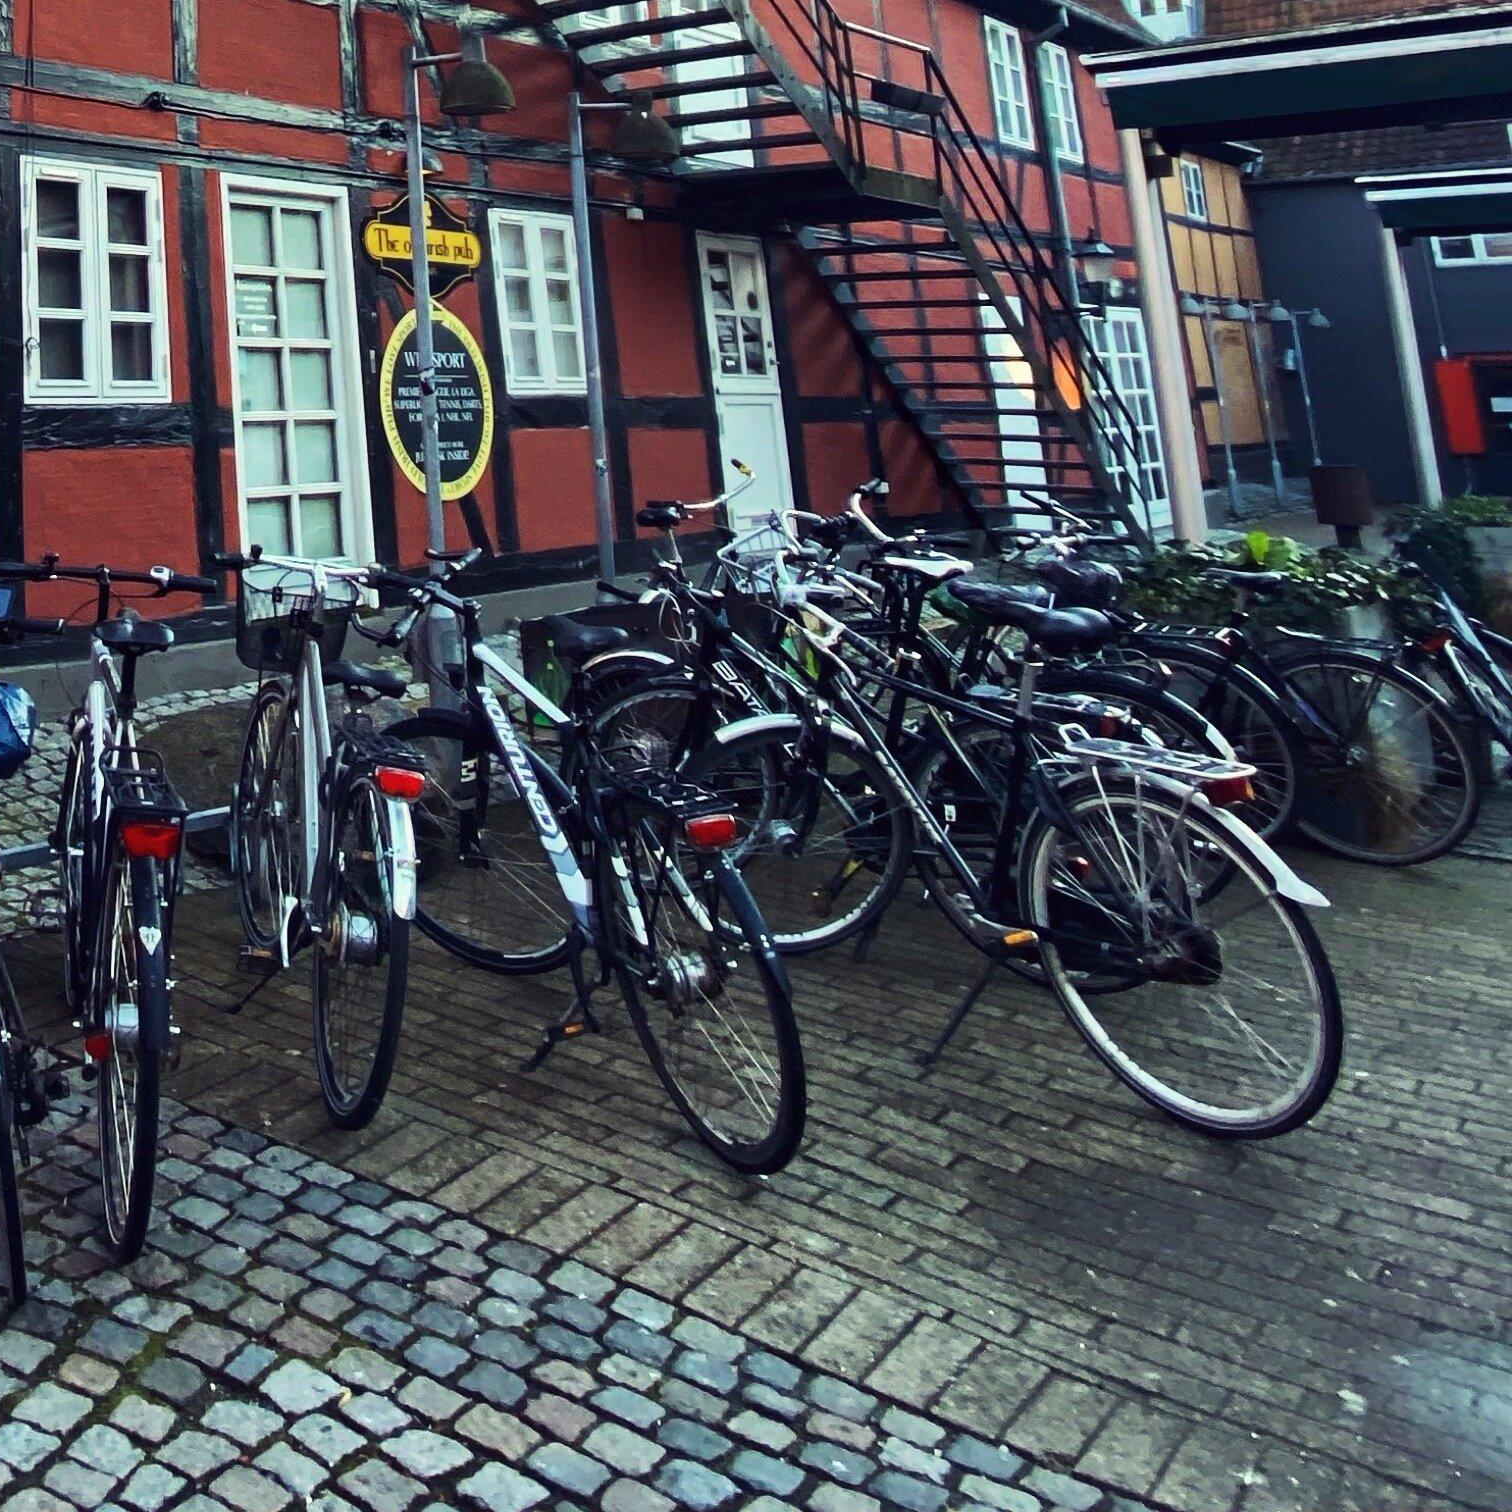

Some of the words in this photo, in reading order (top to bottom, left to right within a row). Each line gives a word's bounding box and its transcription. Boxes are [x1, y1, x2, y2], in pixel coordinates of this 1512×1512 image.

[374, 228, 399, 253] The
[453, 236, 474, 261] pub
[431, 352, 467, 368] SPORT
[475, 685, 559, 835] CENTURION
